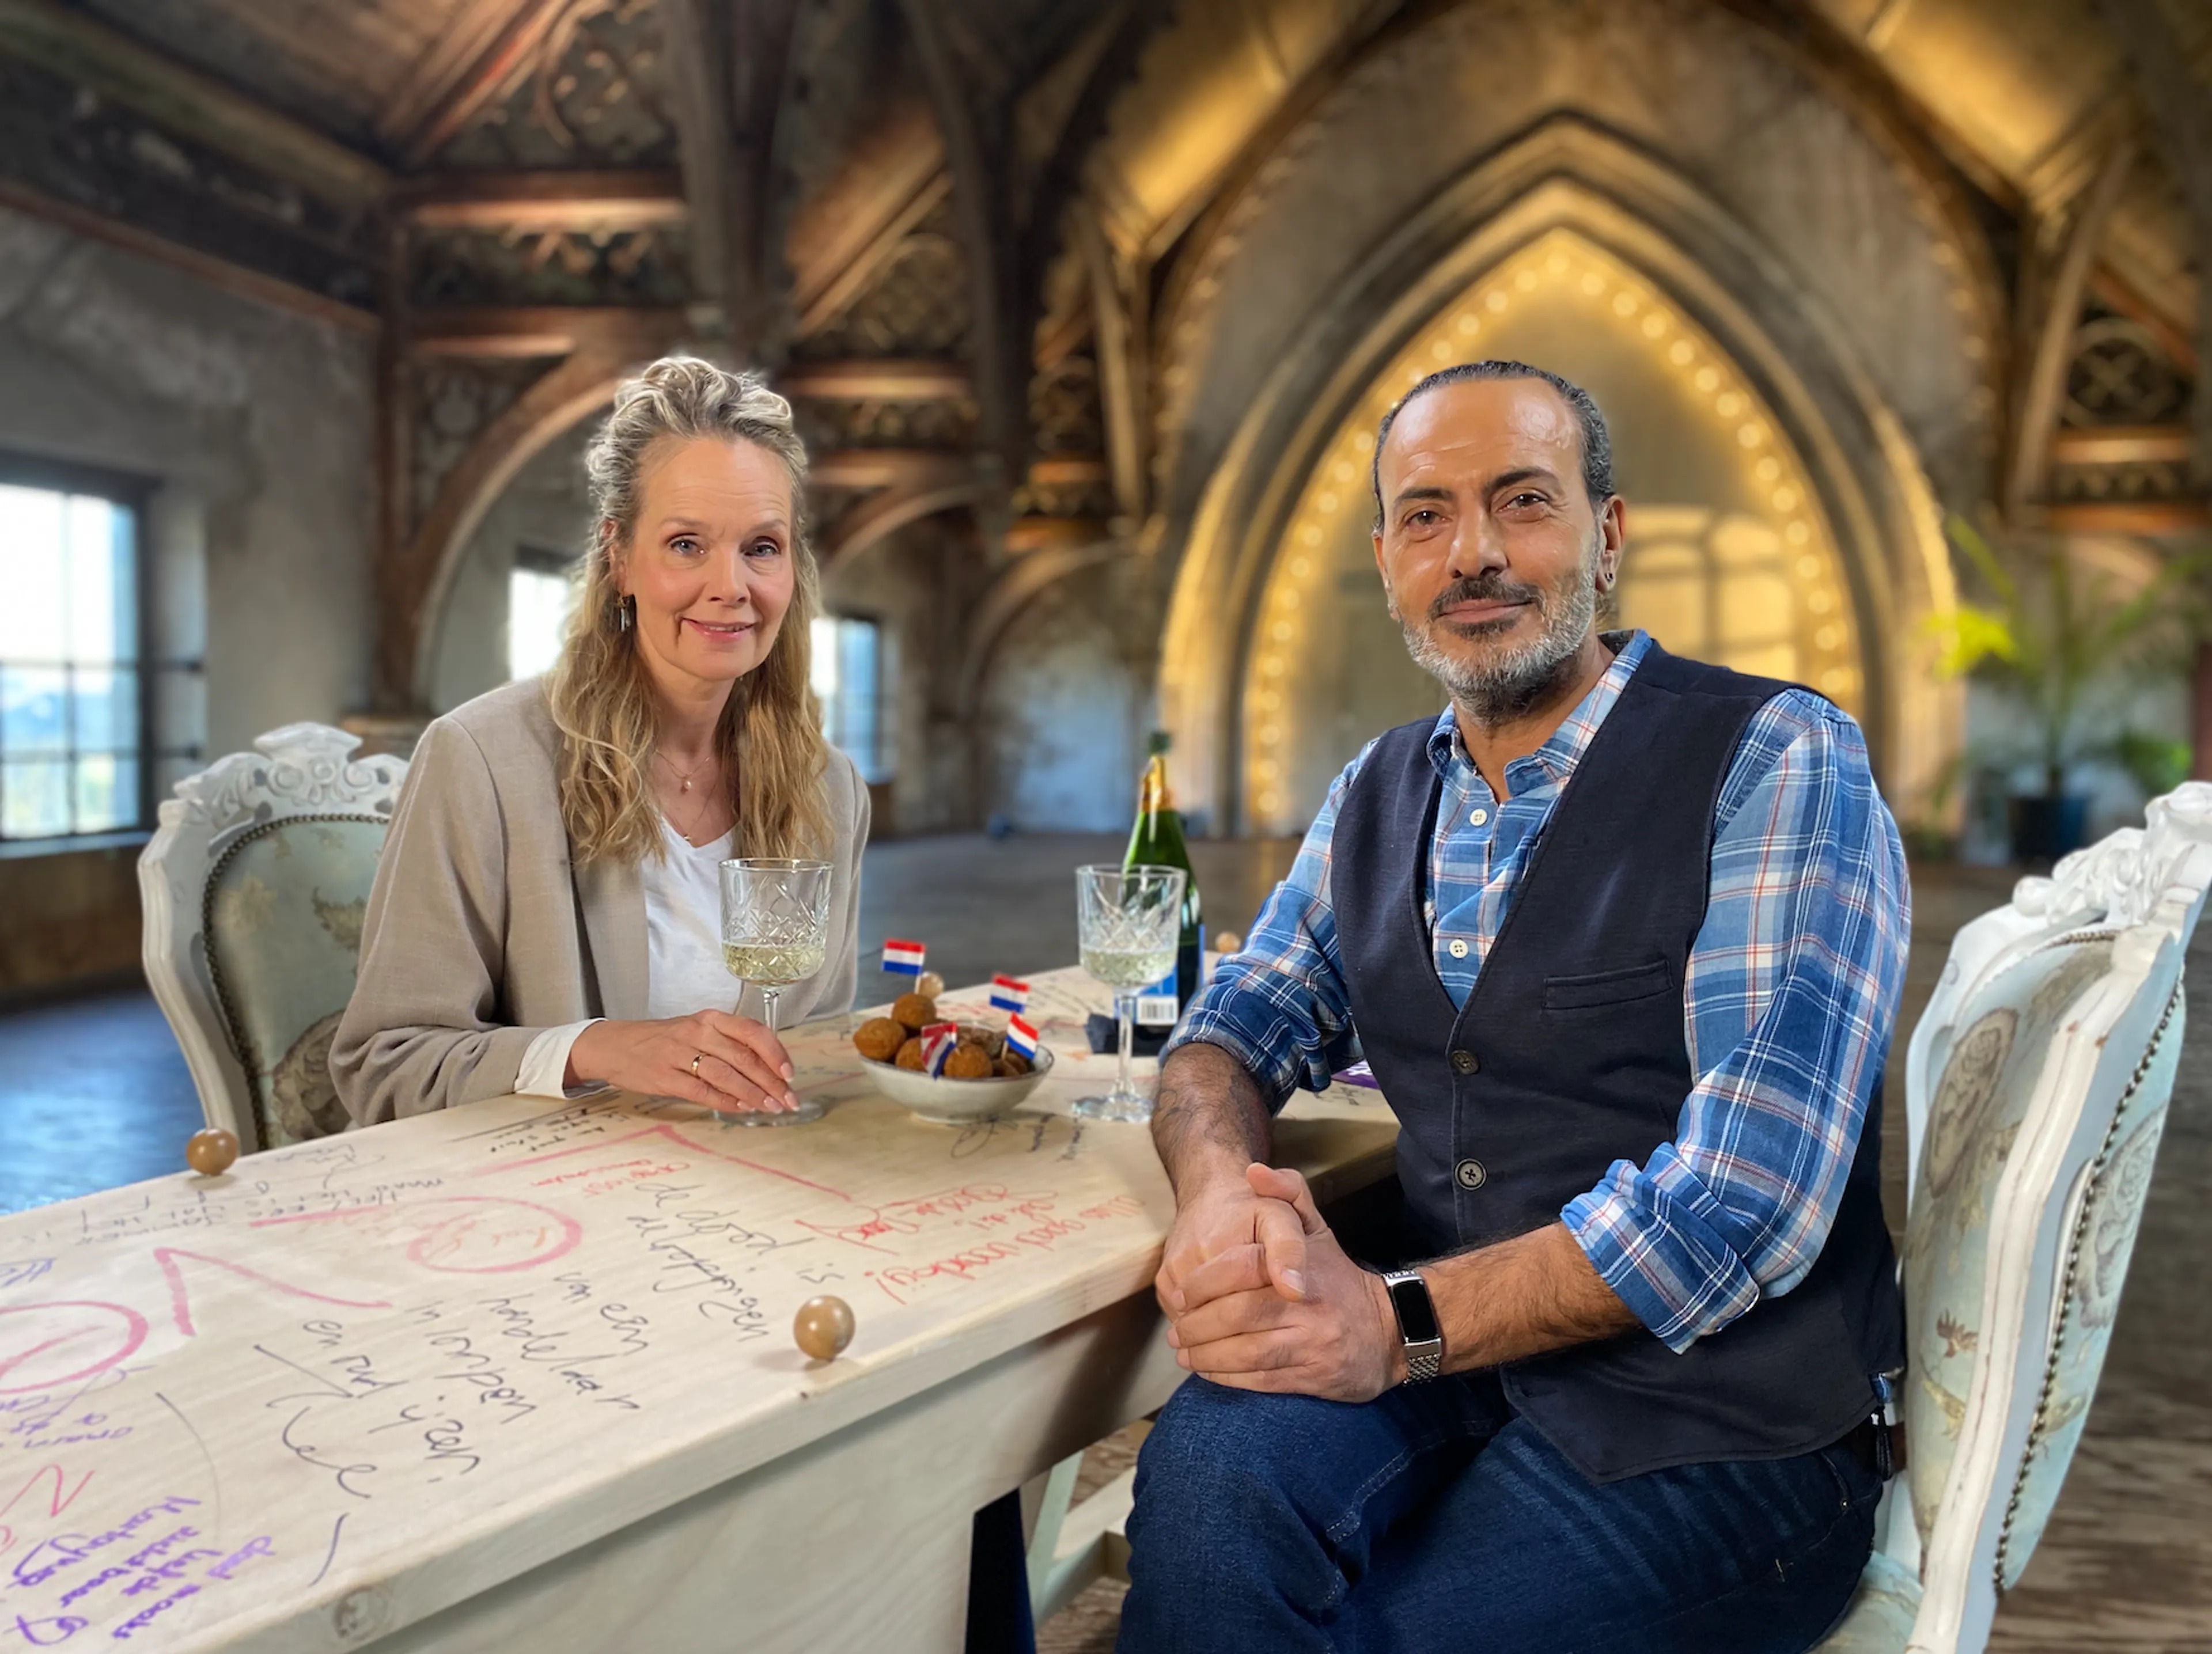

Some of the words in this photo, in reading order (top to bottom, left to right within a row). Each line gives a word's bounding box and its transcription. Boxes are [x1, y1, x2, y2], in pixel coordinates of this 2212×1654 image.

[635, 1182, 706, 1208] de
[676, 1209, 815, 1256] dood
[796, 1262, 845, 1284] is
[303, 1319, 343, 1349] en
[478, 1293, 641, 1409] handelaar
[600, 1303, 649, 1356] een
[120, 1549, 224, 1596] liefde
[205, 1535, 278, 1580] dood
